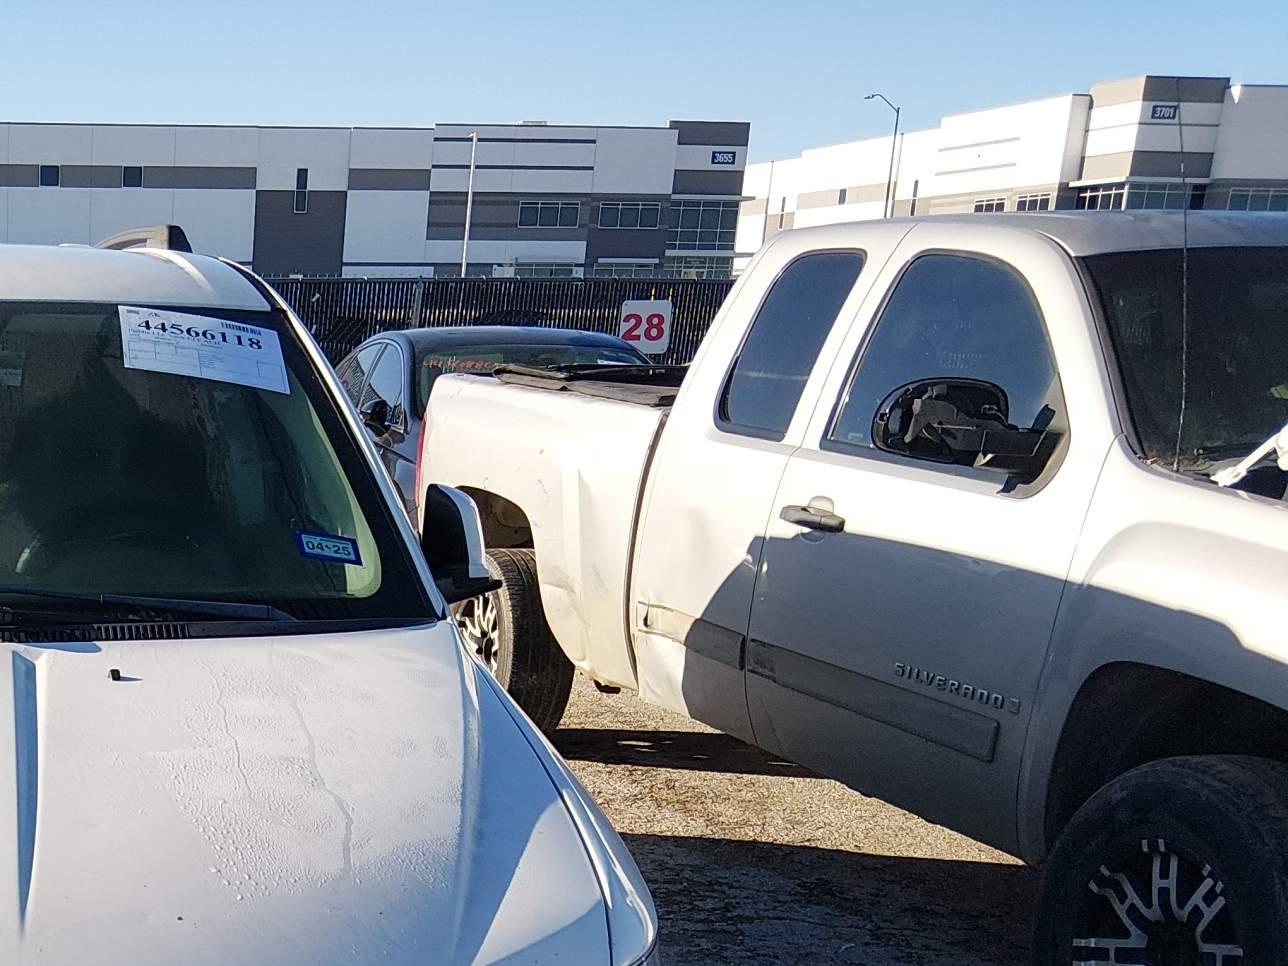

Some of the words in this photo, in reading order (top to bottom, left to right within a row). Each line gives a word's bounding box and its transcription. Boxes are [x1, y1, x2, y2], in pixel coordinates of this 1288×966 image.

[1154, 107, 1175, 118] 3701
[714, 153, 734, 163] 3655
[137, 319, 263, 350] 44566118
[621, 313, 665, 341] 28
[895, 662, 1005, 710] SILVERADO
